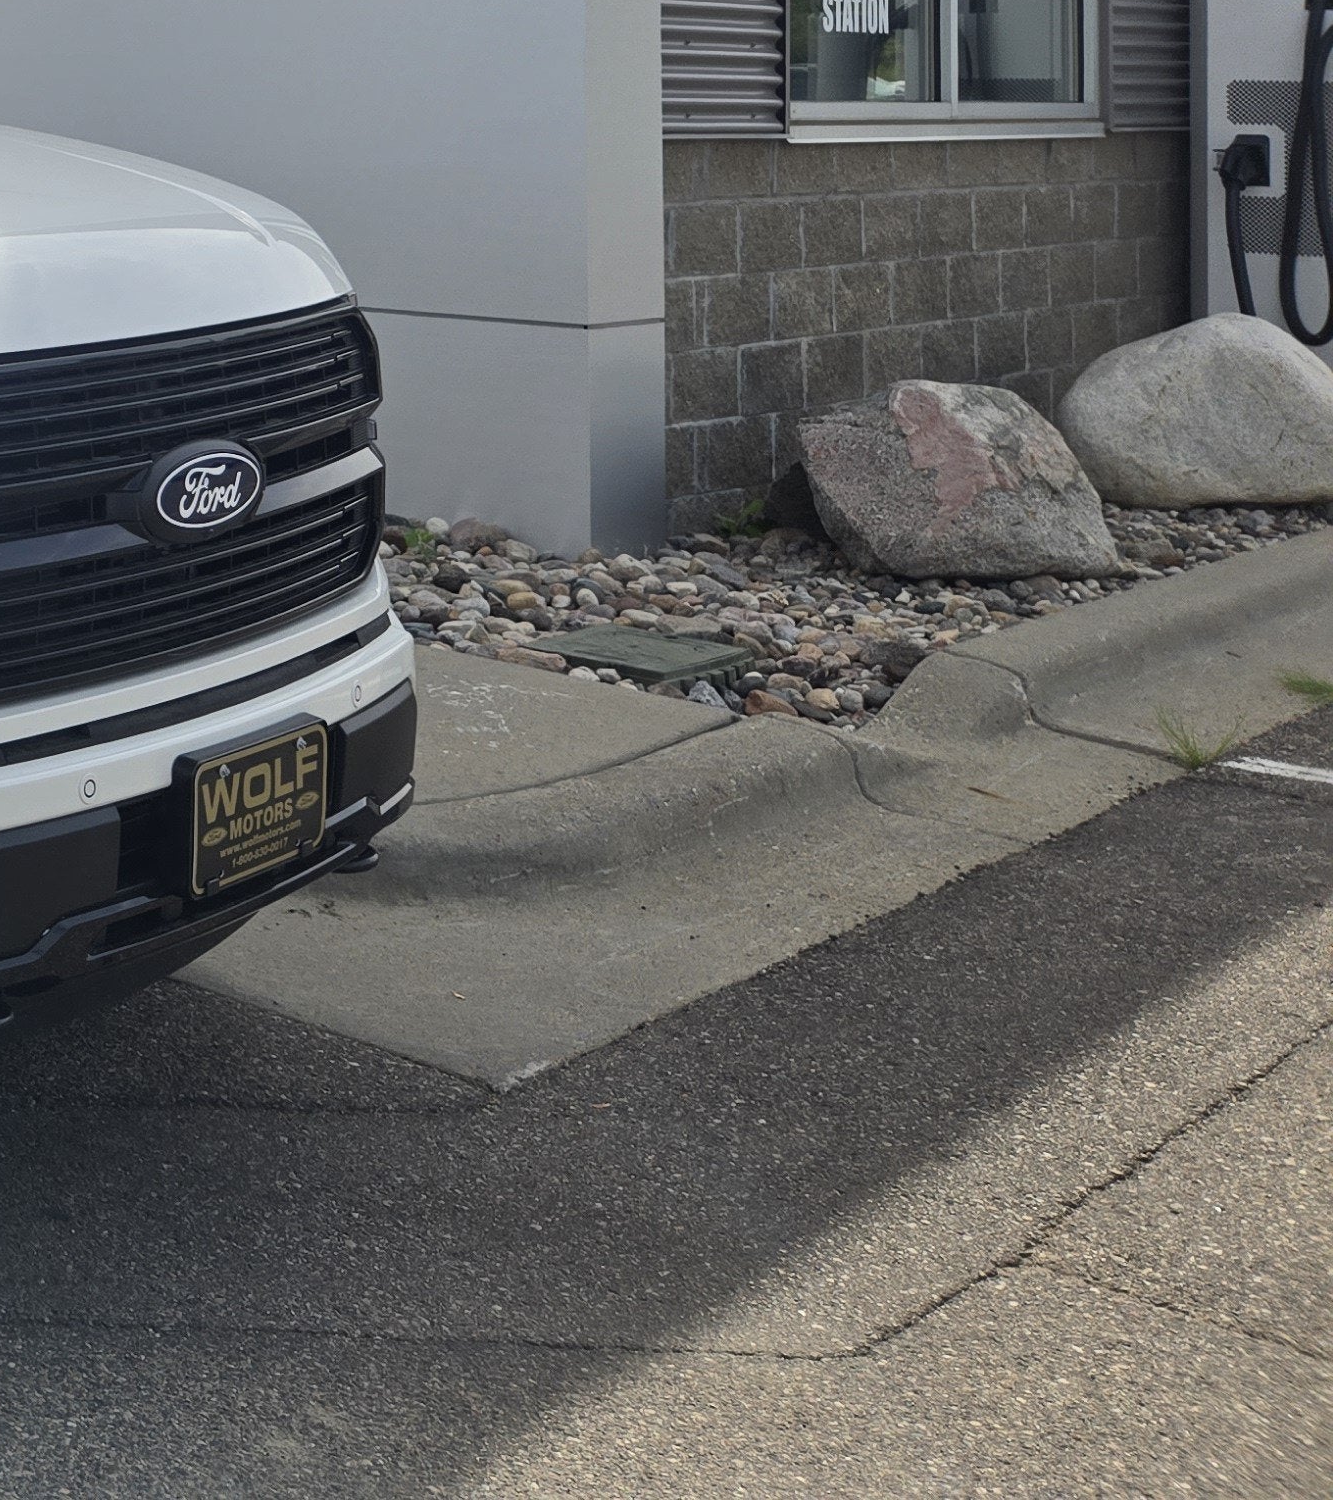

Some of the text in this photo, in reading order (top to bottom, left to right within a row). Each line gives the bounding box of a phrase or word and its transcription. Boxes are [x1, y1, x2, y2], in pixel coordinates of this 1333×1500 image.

[179, 464, 242, 518] Ford
[202, 744, 318, 824] WOLF
[219, 819, 302, 858] www.wolfmotors.com
[229, 798, 294, 841] MOTORS
